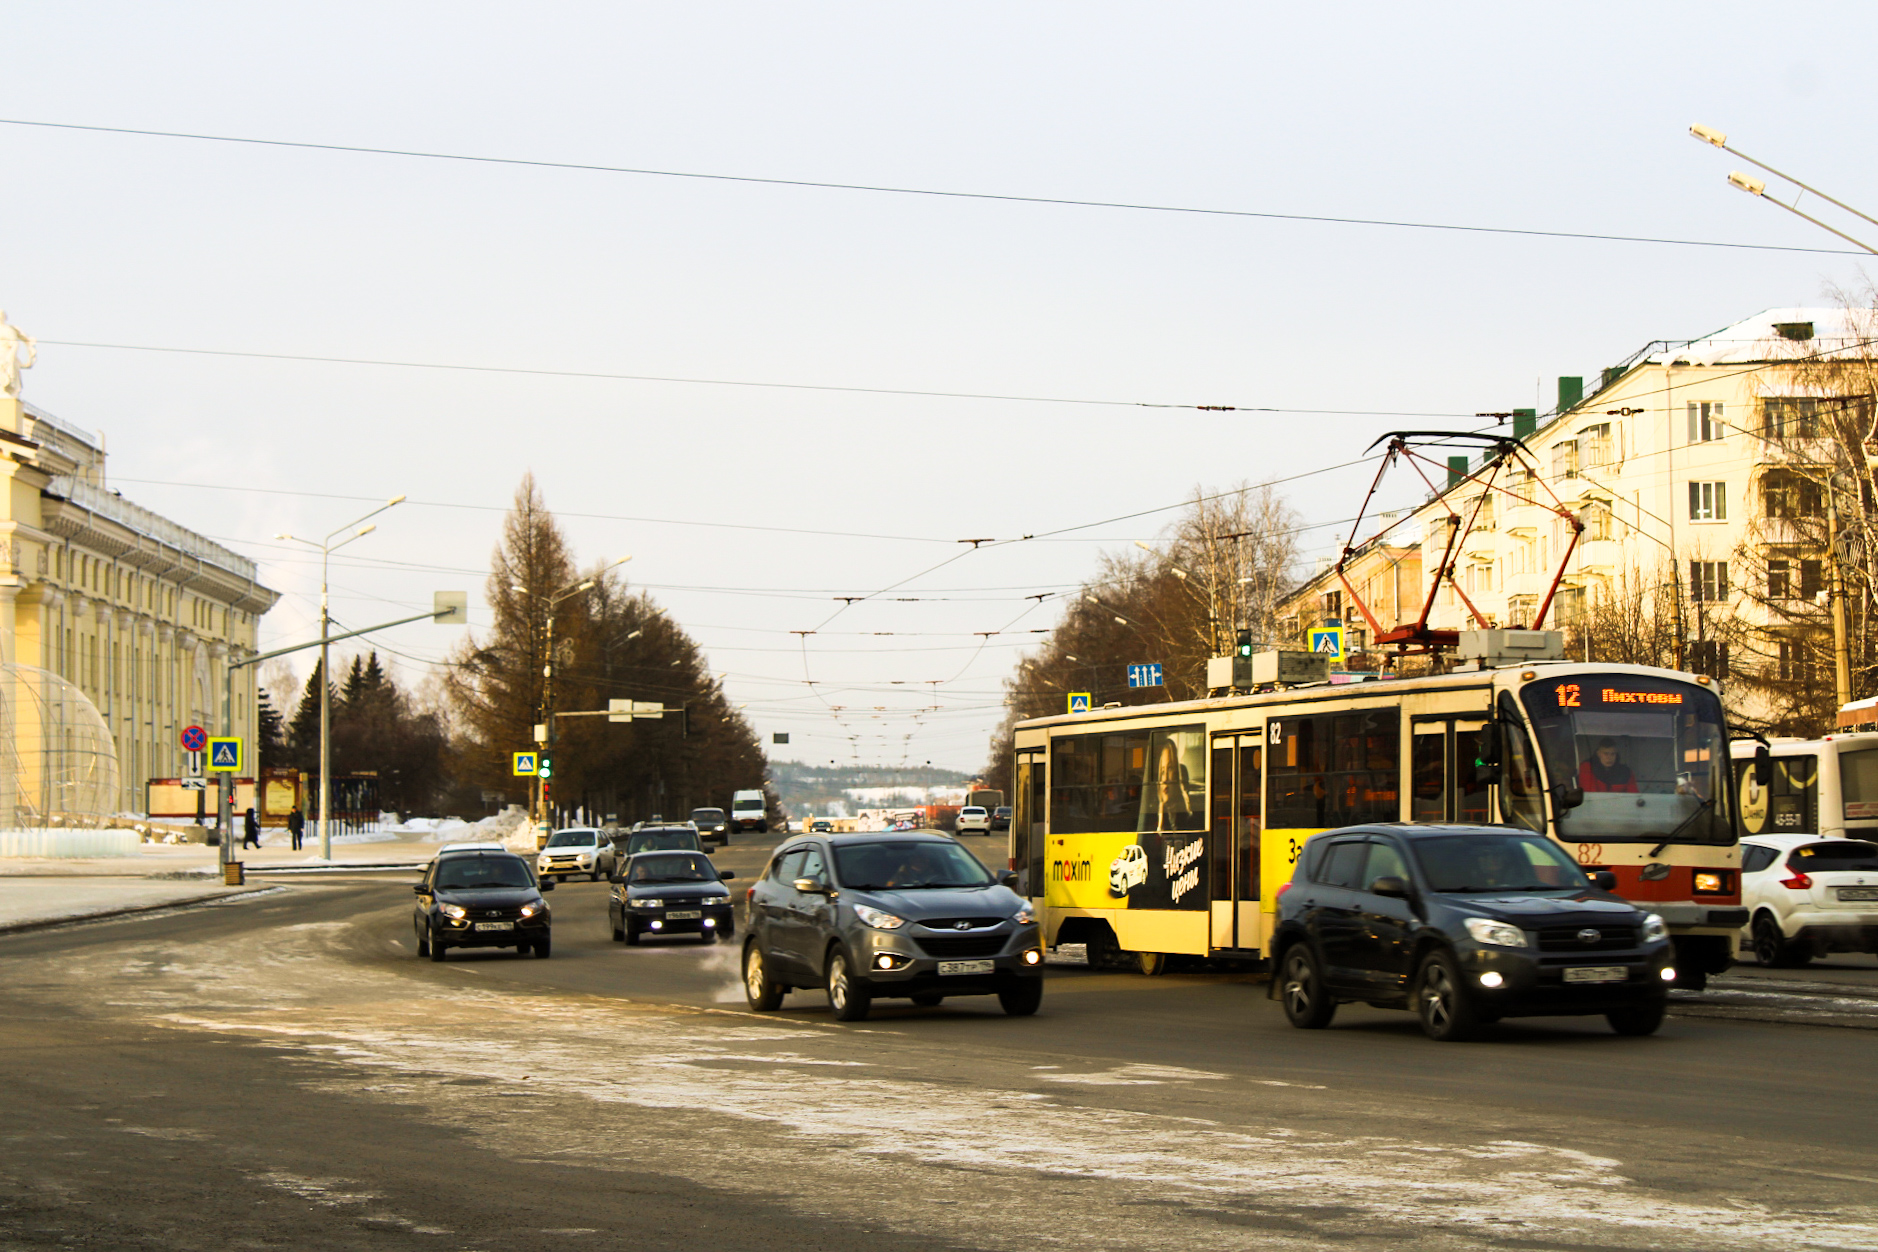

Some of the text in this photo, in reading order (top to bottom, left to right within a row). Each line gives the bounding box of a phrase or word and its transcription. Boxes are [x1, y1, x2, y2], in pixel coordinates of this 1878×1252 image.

[1555, 684, 1682, 707] 12 Пихтовы
[1269, 722, 1281, 744] 82
[1163, 837, 1204, 879] Низкие
[1578, 843, 1603, 864] 82
[1171, 866, 1200, 904] цены
